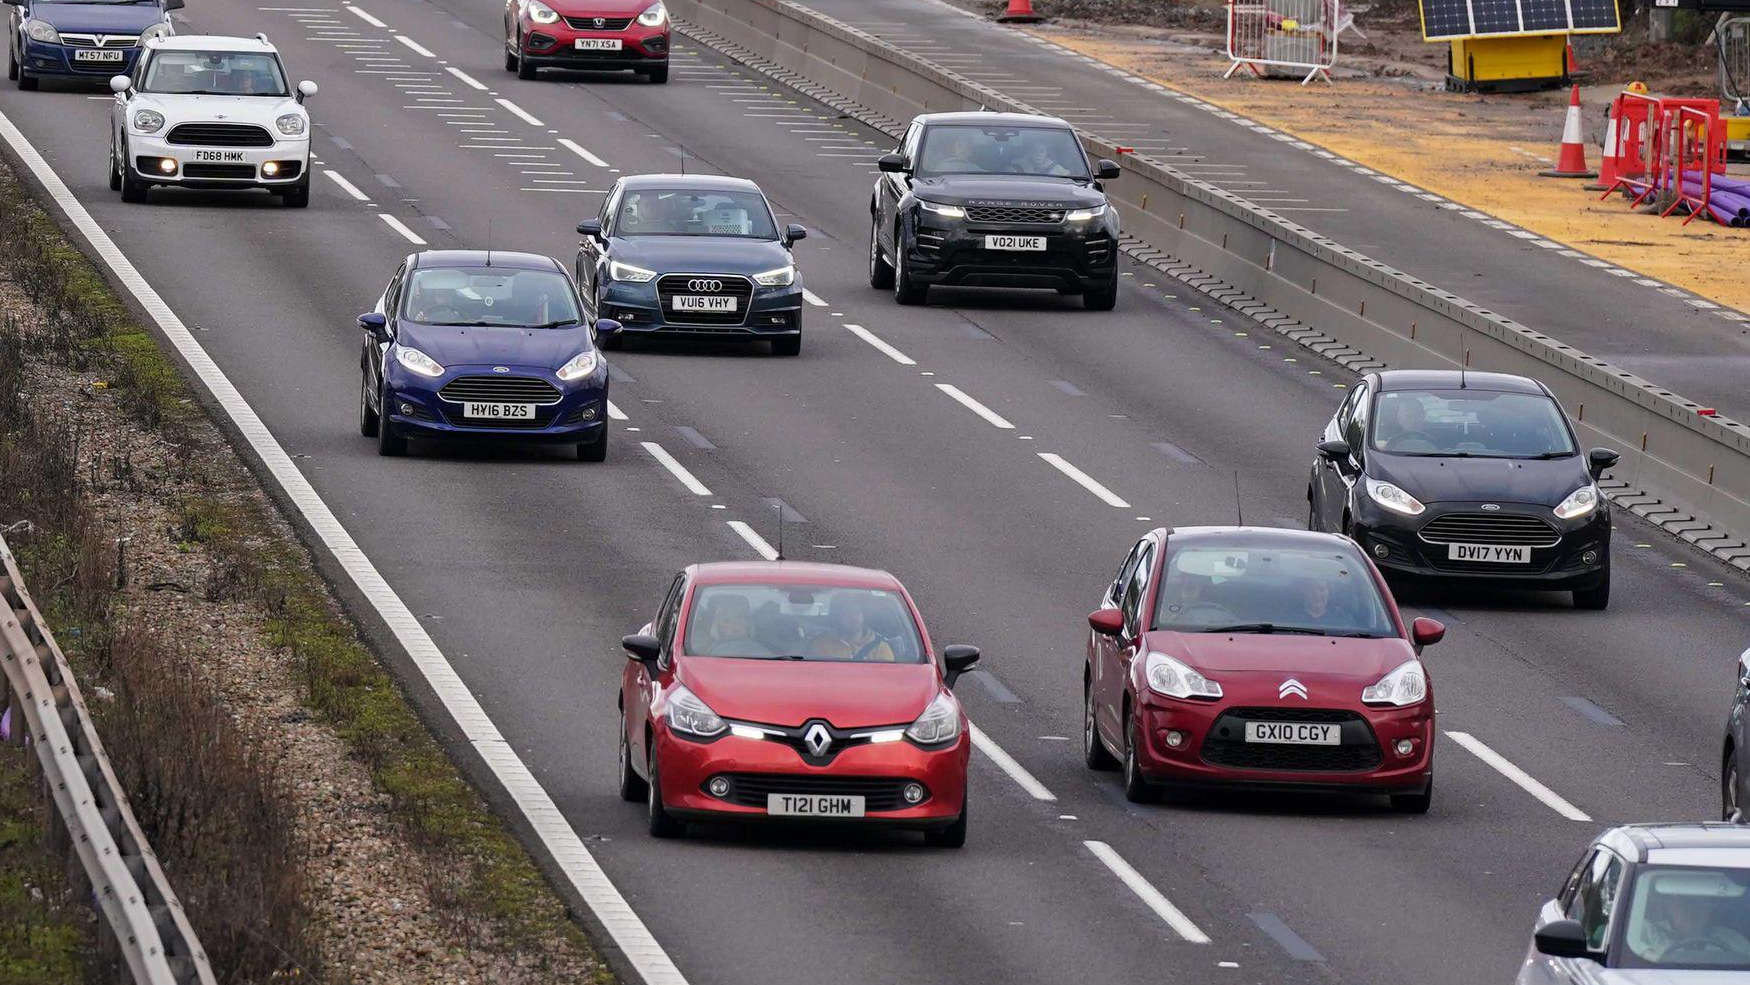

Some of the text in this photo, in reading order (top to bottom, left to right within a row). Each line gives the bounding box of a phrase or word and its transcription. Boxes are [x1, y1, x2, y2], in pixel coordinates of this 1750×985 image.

[580, 40, 616, 48] YN71 XSA
[78, 51, 120, 60] MT57 NFU
[196, 151, 244, 162] FD68 HMK
[1017, 237, 1040, 248] UKE
[680, 297, 730, 308] VU16 VHY
[471, 404, 528, 417] HY16 BZS
[1457, 545, 1523, 561] DV17 YYN
[1256, 724, 1330, 741] GX10 CGY
[782, 797, 851, 814] T121 GHM
